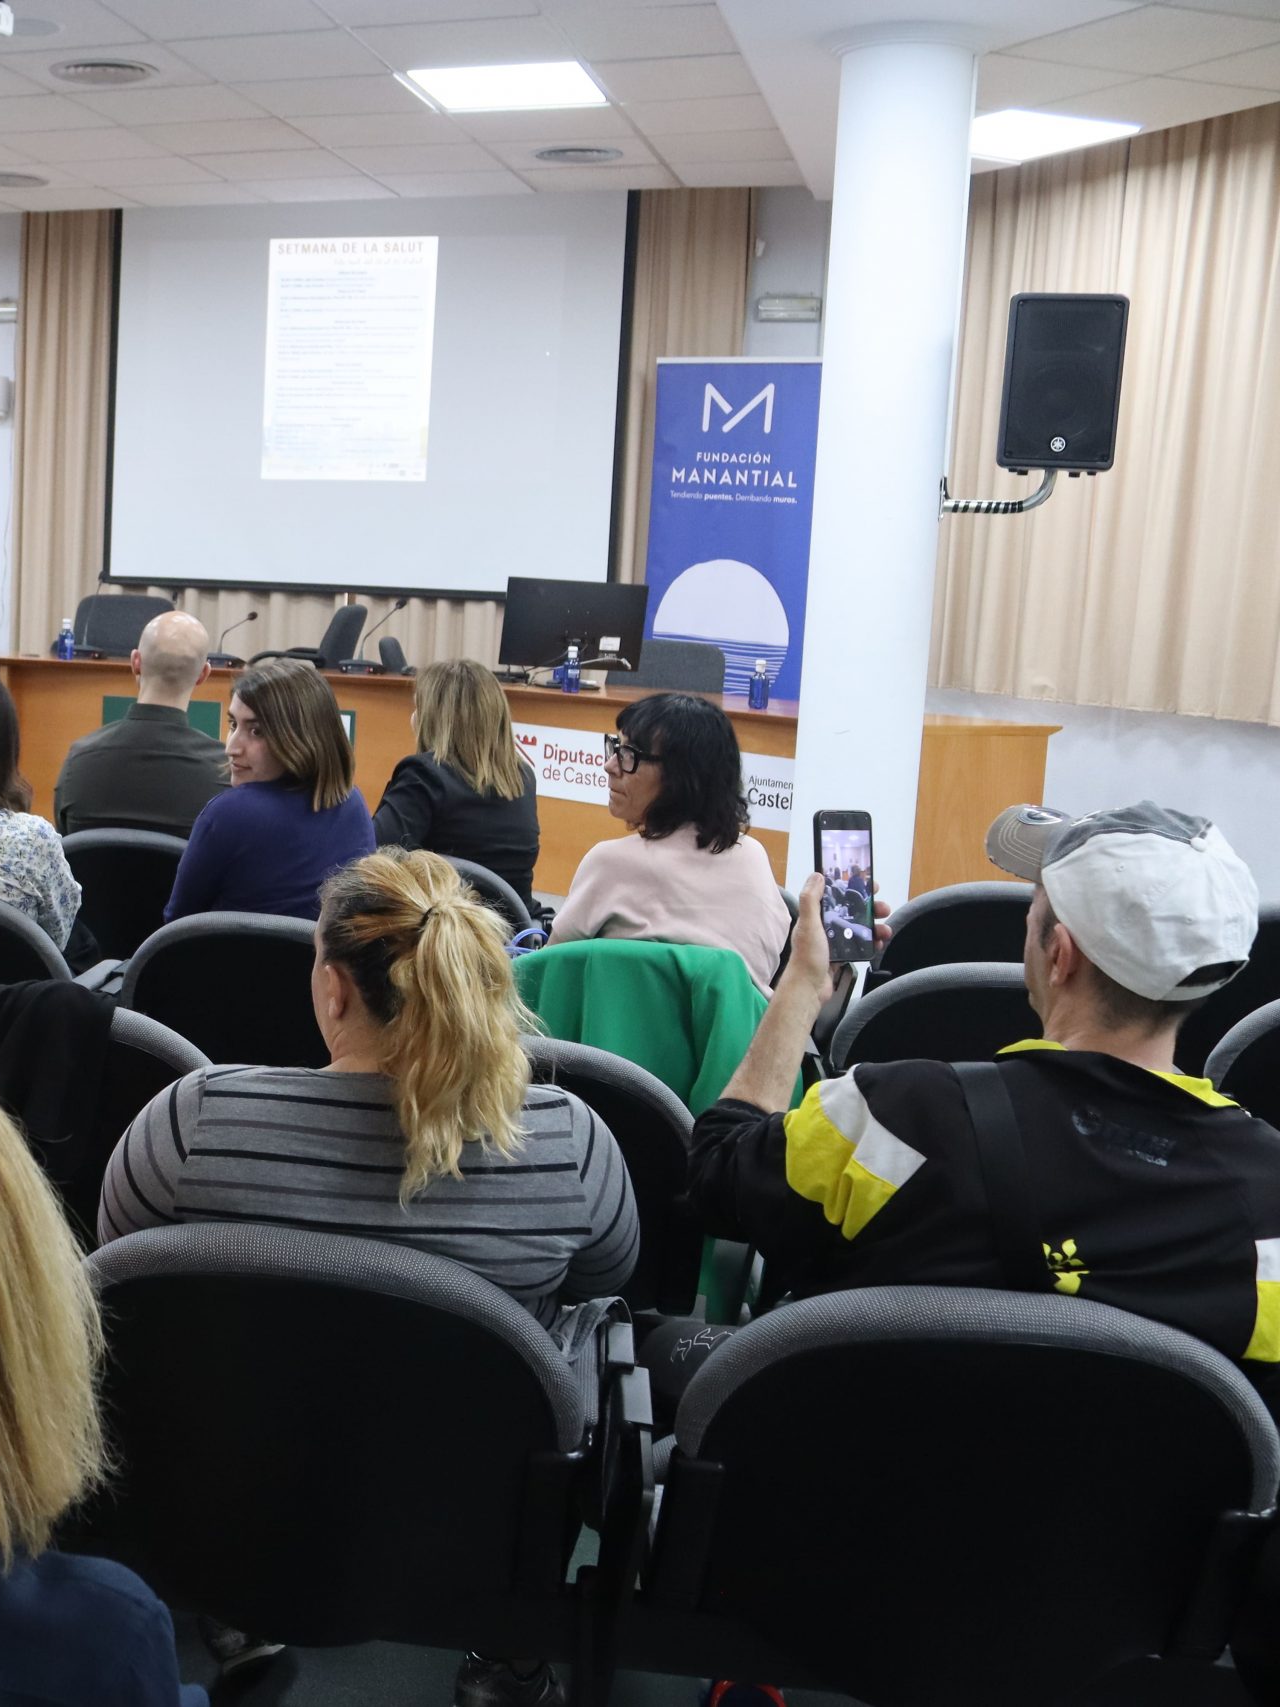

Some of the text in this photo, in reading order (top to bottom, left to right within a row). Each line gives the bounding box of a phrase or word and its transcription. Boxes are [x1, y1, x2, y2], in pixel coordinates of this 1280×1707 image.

[277, 240, 424, 255] SETMANA DE LA SALUT
[696, 451, 771, 464] FUNDACIÓN
[671, 467, 798, 489] MANANTIAL
[670, 489, 798, 504] Tendiendo puentes. Derribando muros.
[542, 764, 561, 781] de
